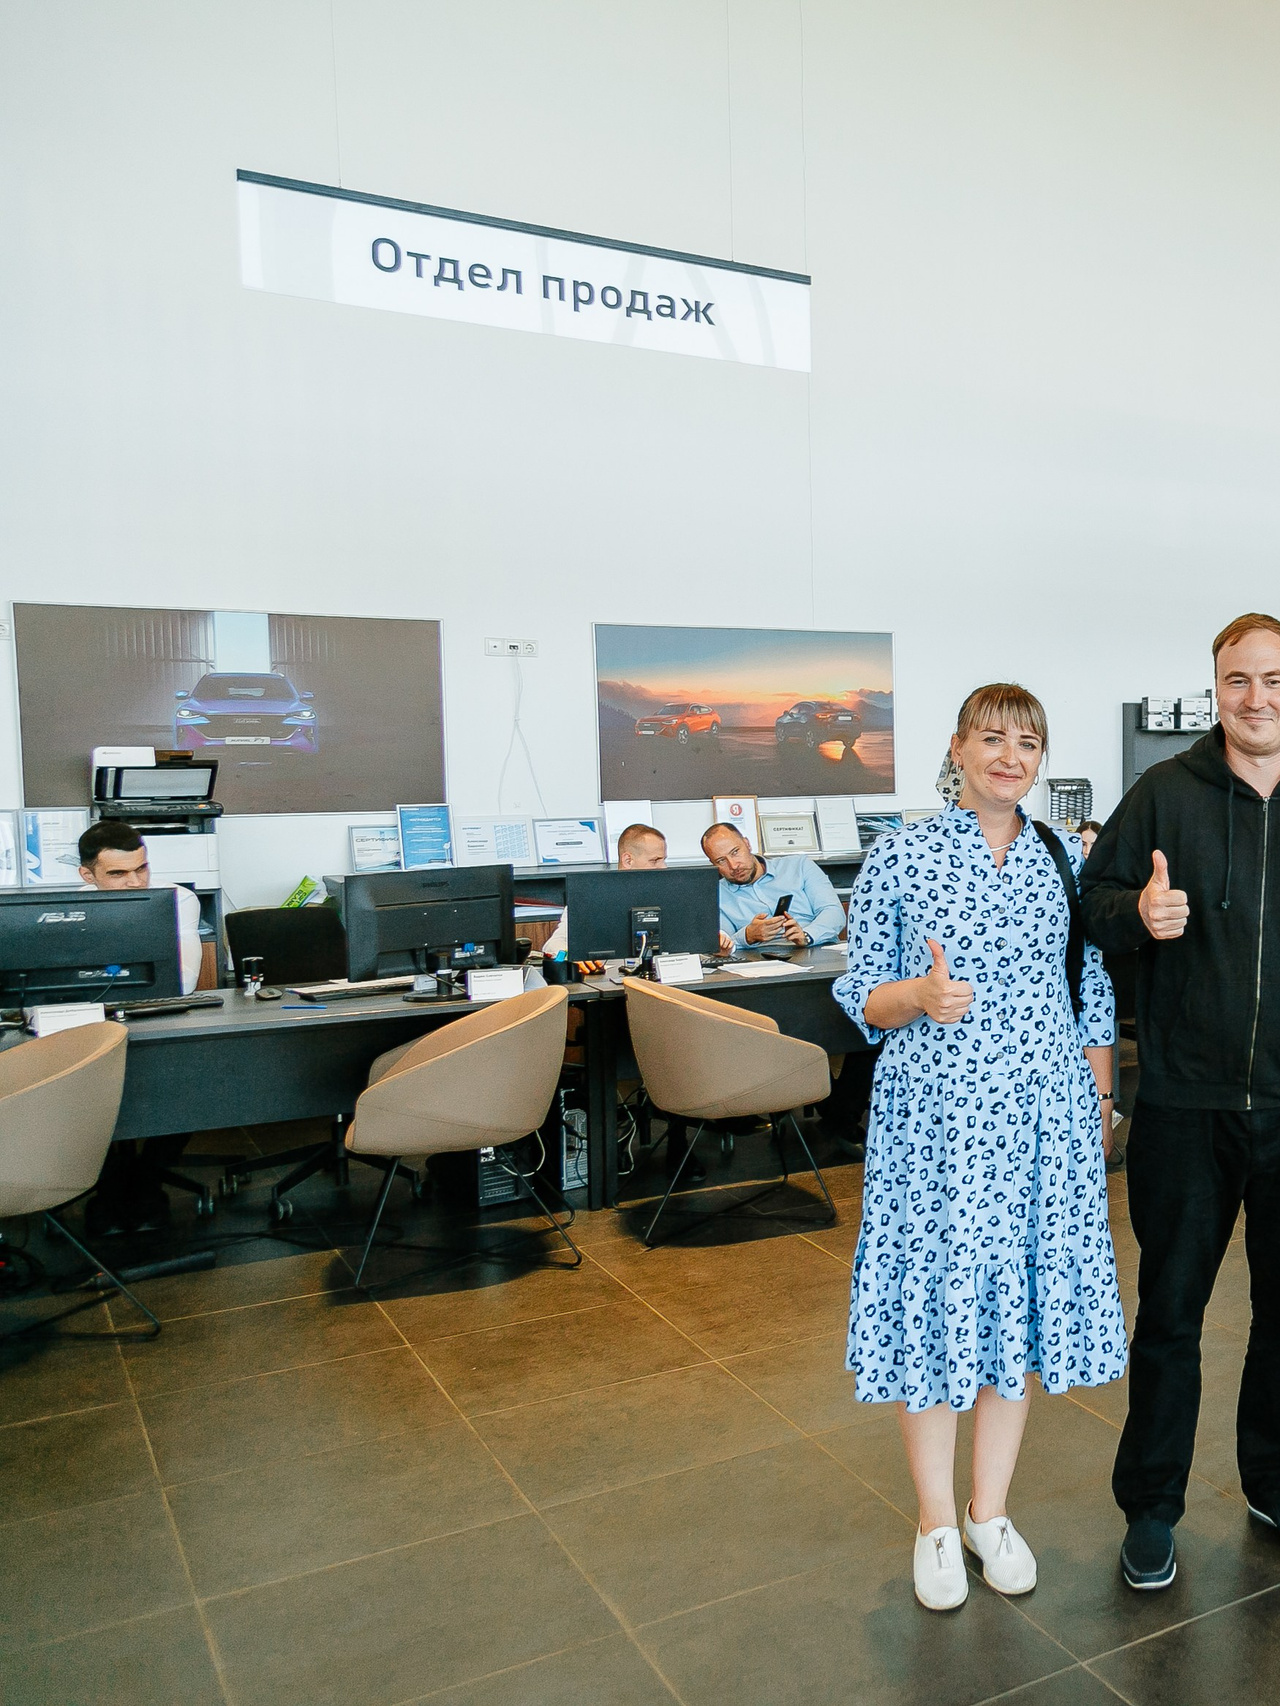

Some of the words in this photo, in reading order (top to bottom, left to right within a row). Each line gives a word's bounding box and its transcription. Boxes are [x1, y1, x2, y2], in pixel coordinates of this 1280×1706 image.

[370, 237, 523, 295] Отдел
[542, 274, 715, 326] продаж
[37, 911, 86, 923] ASUS
